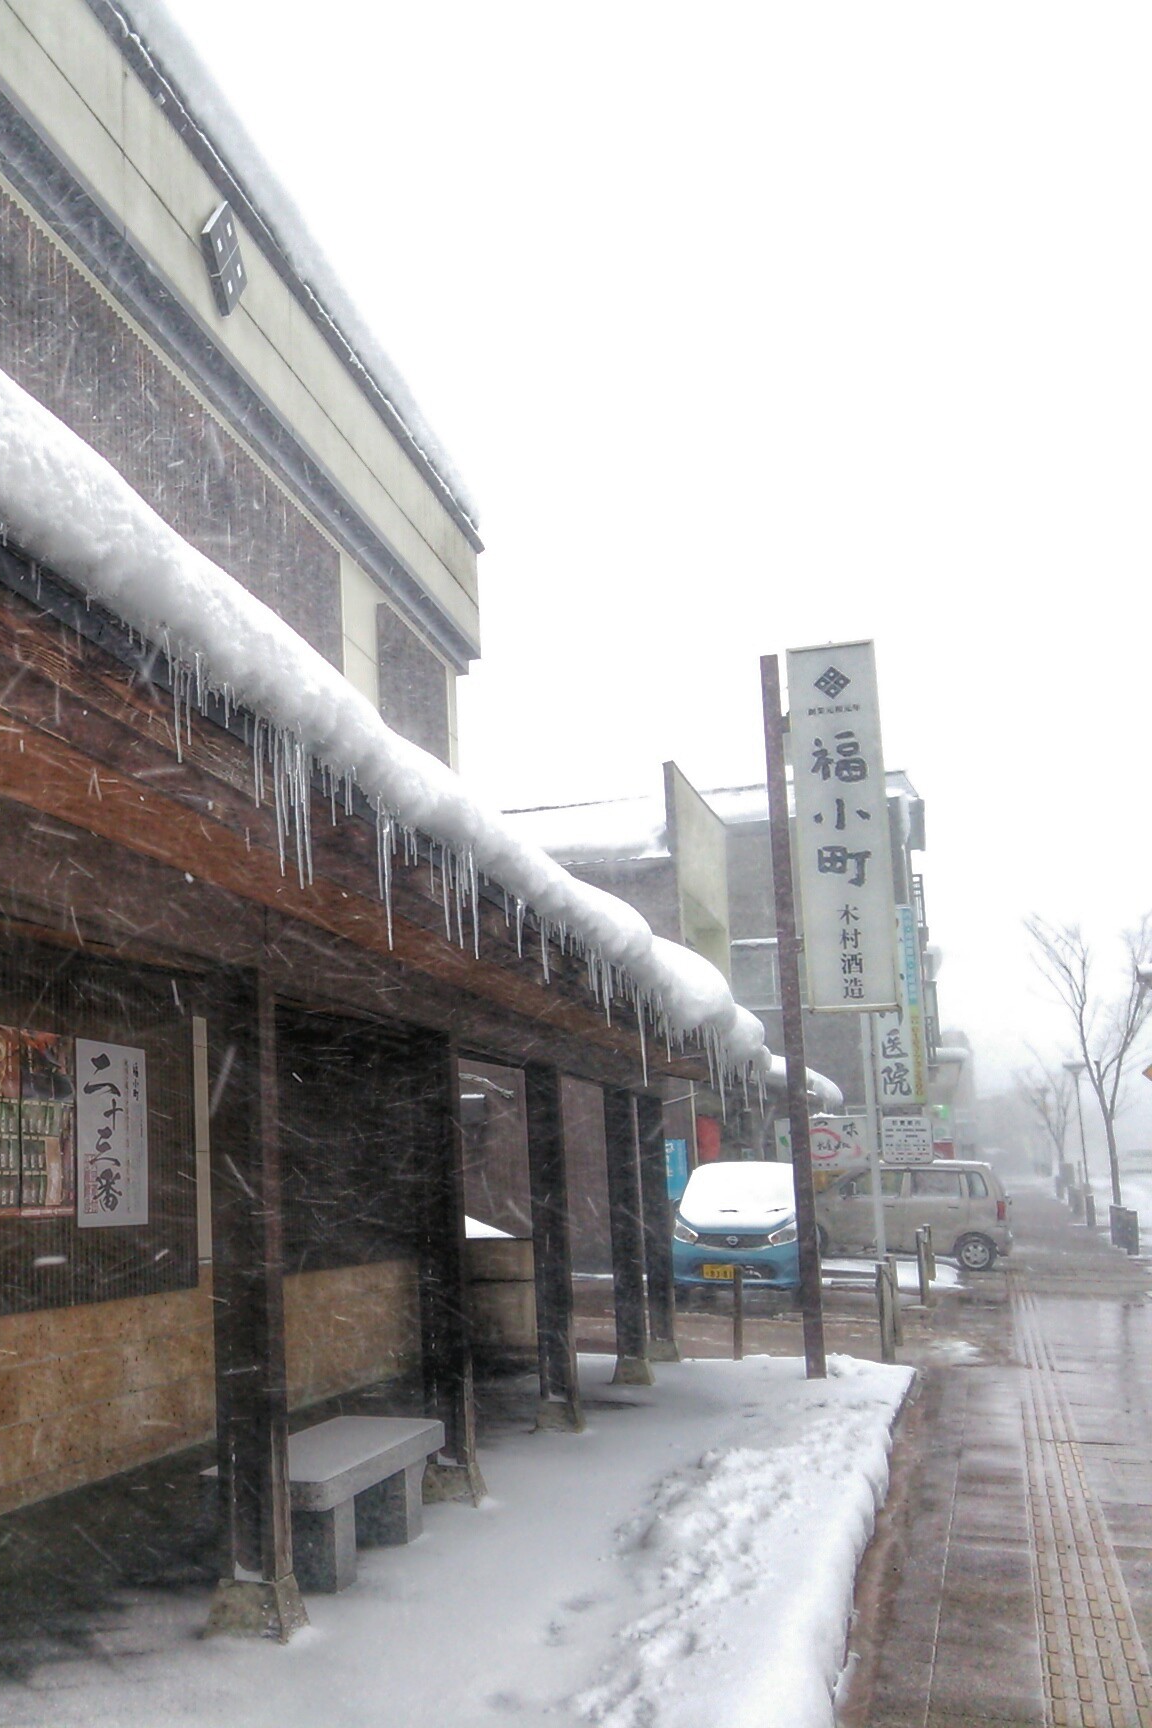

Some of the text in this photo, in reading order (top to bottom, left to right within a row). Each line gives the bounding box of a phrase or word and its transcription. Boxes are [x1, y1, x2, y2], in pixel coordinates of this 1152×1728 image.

[811, 730, 872, 888] 福小町
[839, 904, 866, 1000] 木村酒造
